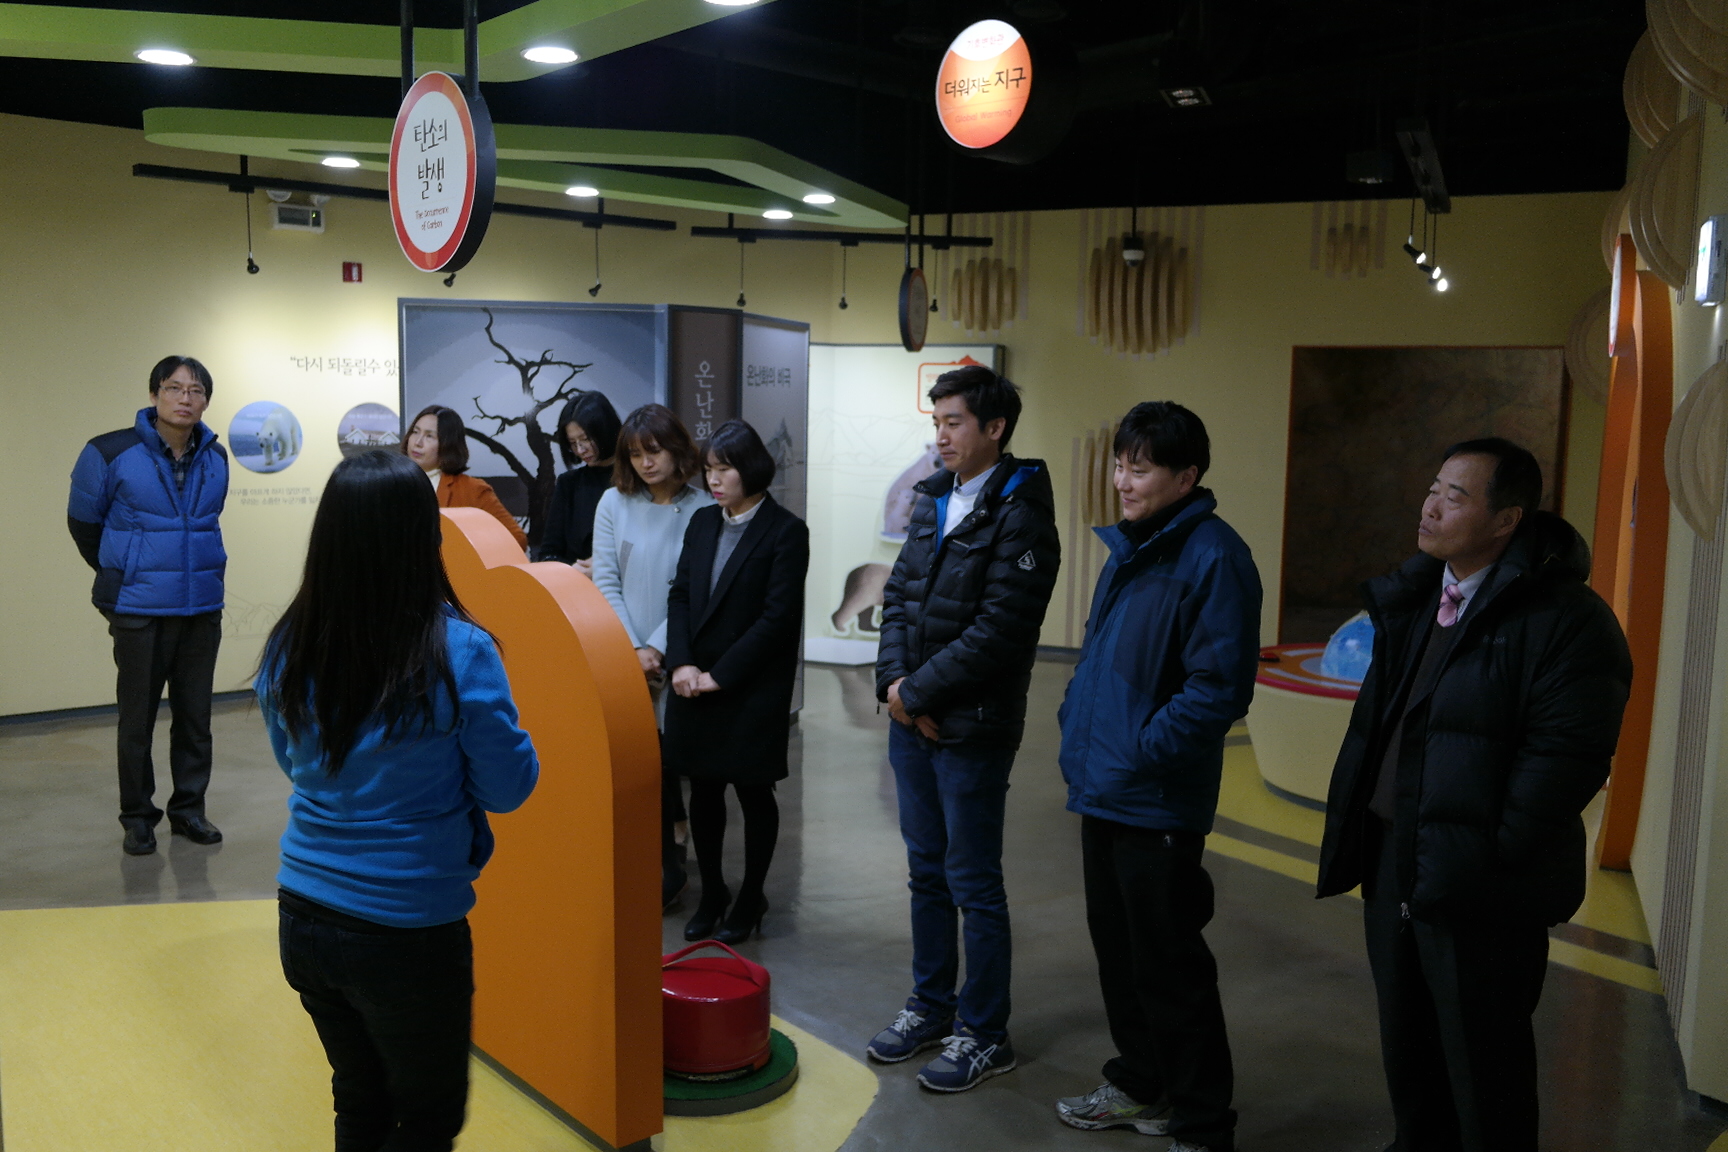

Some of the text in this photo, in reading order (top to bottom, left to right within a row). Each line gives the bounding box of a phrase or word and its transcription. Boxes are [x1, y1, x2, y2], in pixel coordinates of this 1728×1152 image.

[944, 66, 1026, 98] 더워지는 지구
[413, 118, 448, 152] 탄소의
[417, 157, 445, 200] 발생
[384, 359, 399, 377] 있
